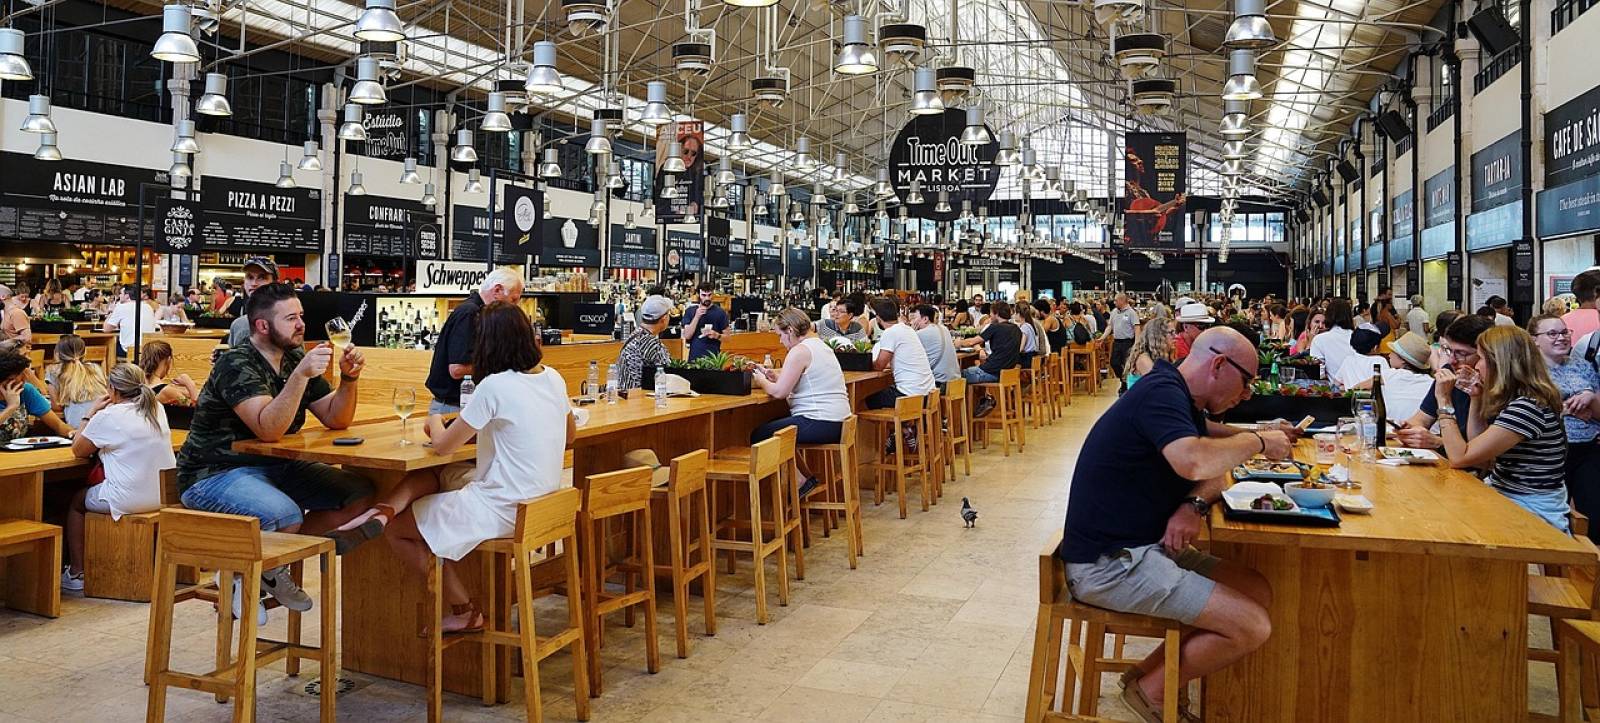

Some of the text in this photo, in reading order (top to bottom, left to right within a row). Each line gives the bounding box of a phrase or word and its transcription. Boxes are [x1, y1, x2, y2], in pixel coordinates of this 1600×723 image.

[364, 112, 404, 130] Estúdio
[1553, 120, 1571, 160] CAFÉ
[1573, 120, 1584, 152] DE
[907, 136, 978, 166] Time Out
[53, 172, 126, 196] ASIAN LAB
[898, 168, 990, 182] MARKET
[928, 184, 960, 192] LISBOA
[228, 191, 295, 212] PIZZA A PEZZI
[164, 226, 194, 236] GINJA
[165, 218, 188, 228] CASA
